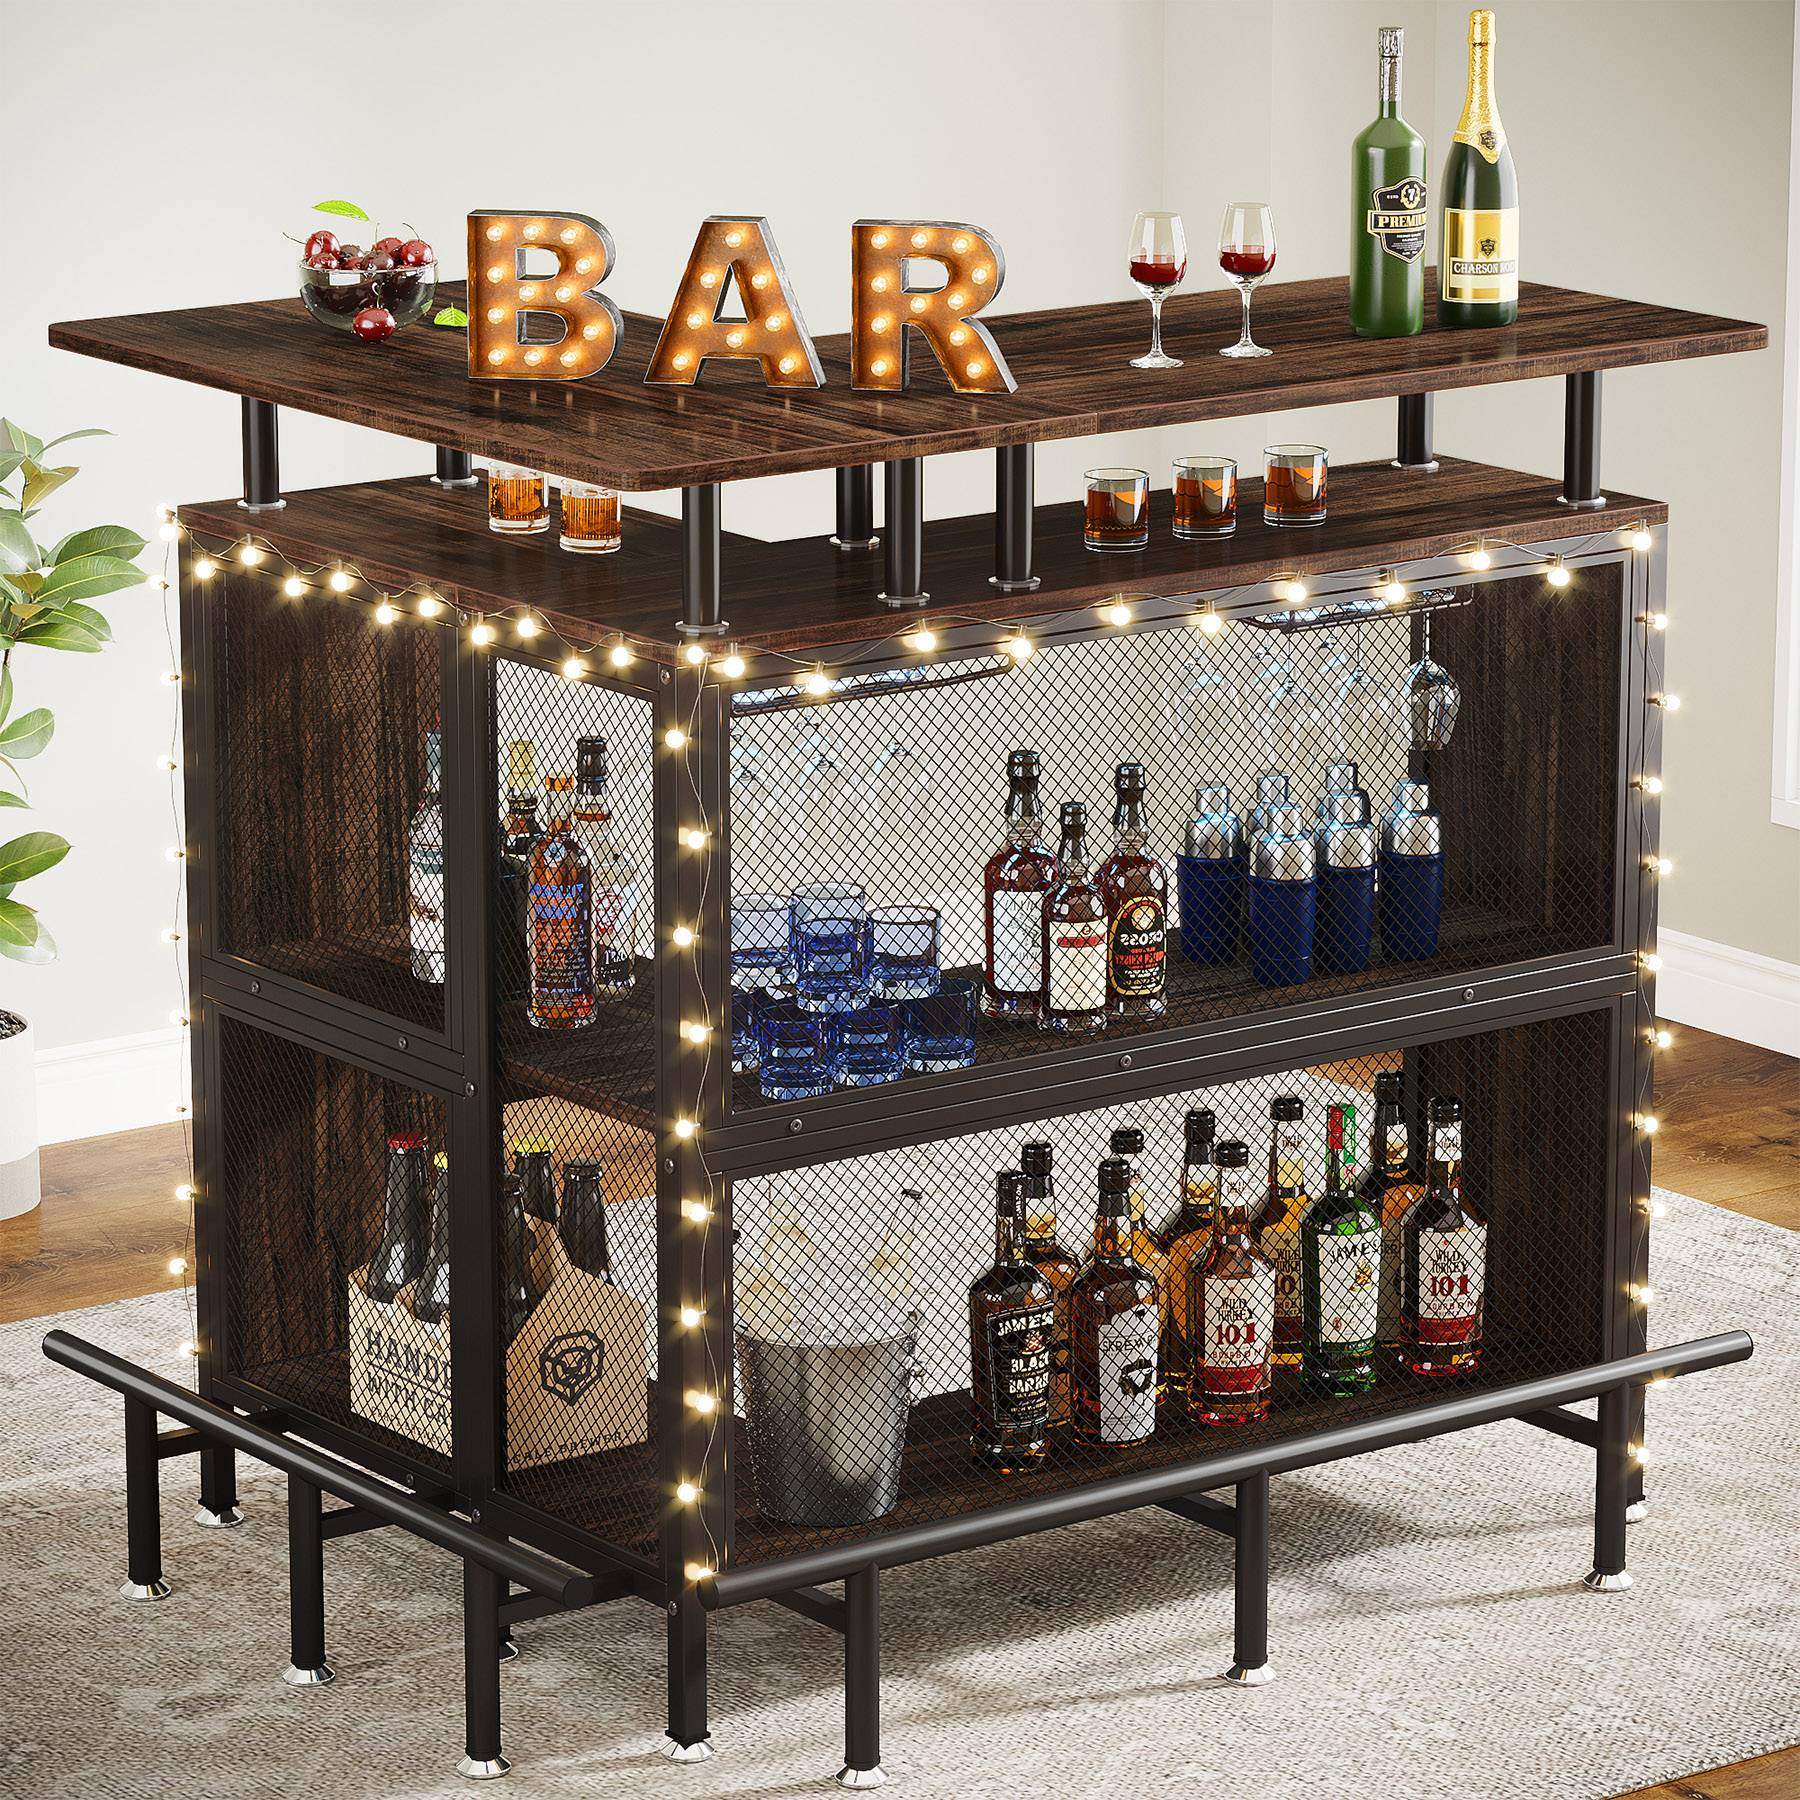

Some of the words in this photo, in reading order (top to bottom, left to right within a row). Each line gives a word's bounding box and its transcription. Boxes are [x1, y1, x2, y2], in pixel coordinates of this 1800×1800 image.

[1453, 262, 1499, 274] CHARSON
[467, 209, 1019, 394] BAR
[1430, 1274, 1470, 1296] 101
[1215, 1321, 1257, 1345] 101
